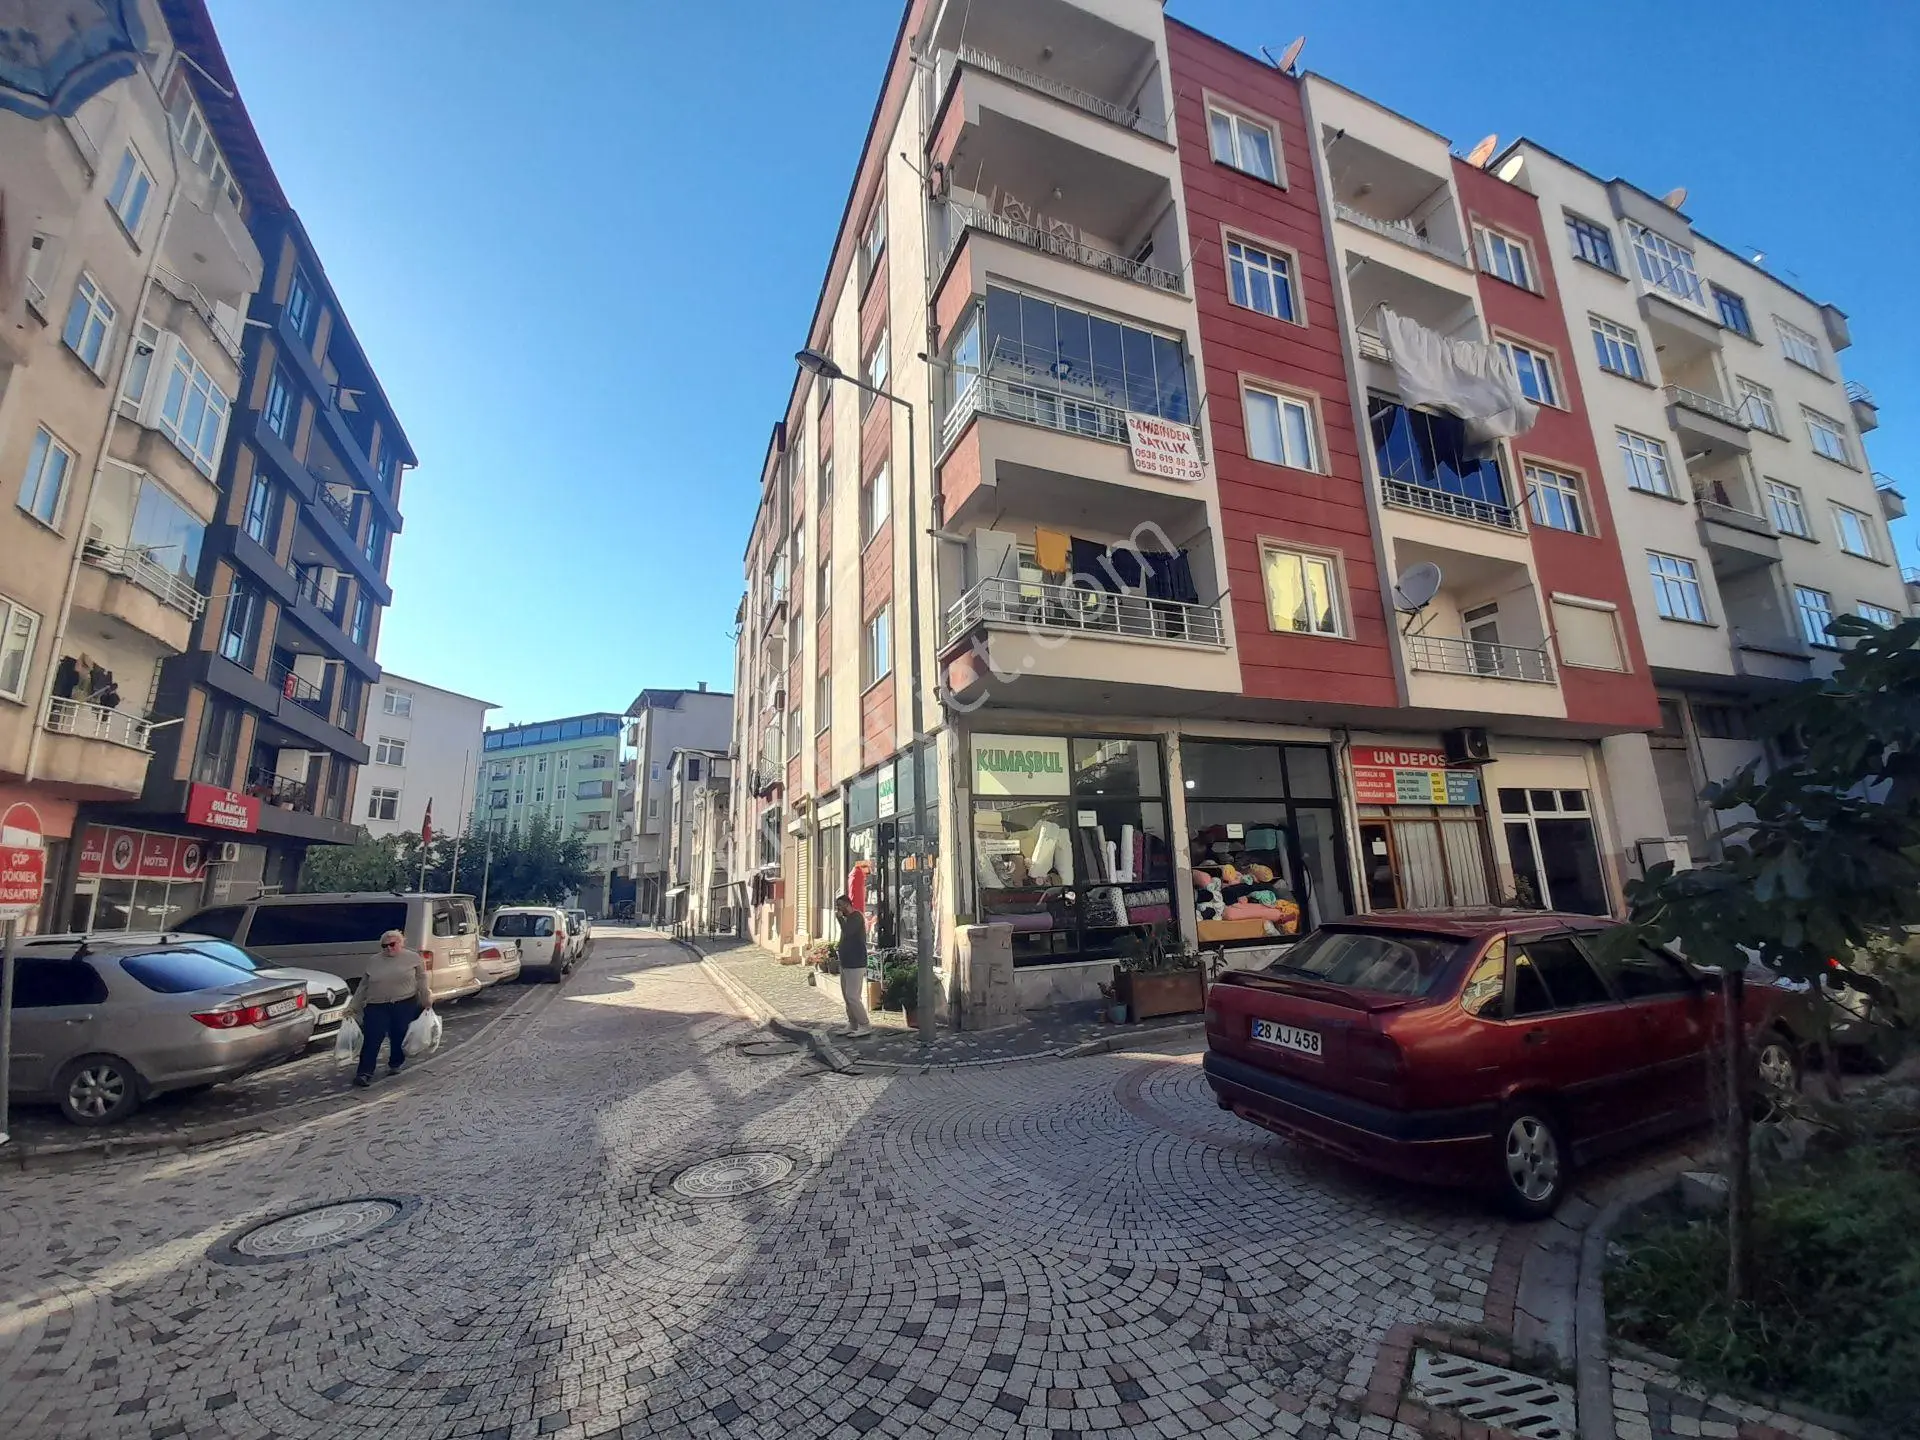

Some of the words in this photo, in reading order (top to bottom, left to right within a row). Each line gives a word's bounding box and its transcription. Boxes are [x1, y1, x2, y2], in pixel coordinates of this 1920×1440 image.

[1137, 432, 1190, 455] SATILIK
[1134, 448, 1157, 460] 0538
[1159, 454, 1173, 464] 619
[1135, 459, 1157, 471] 0535
[1159, 464, 1174, 475] 103
[1176, 468, 1186, 477] 77
[1373, 751, 1396, 765] UN
[1399, 752, 1446, 766] DEPOS
[143, 856, 168, 867] NOTER
[1257, 1022, 1272, 1039] 28
[1275, 1027, 1291, 1044] AJ
[1294, 1031, 1319, 1052] 458
